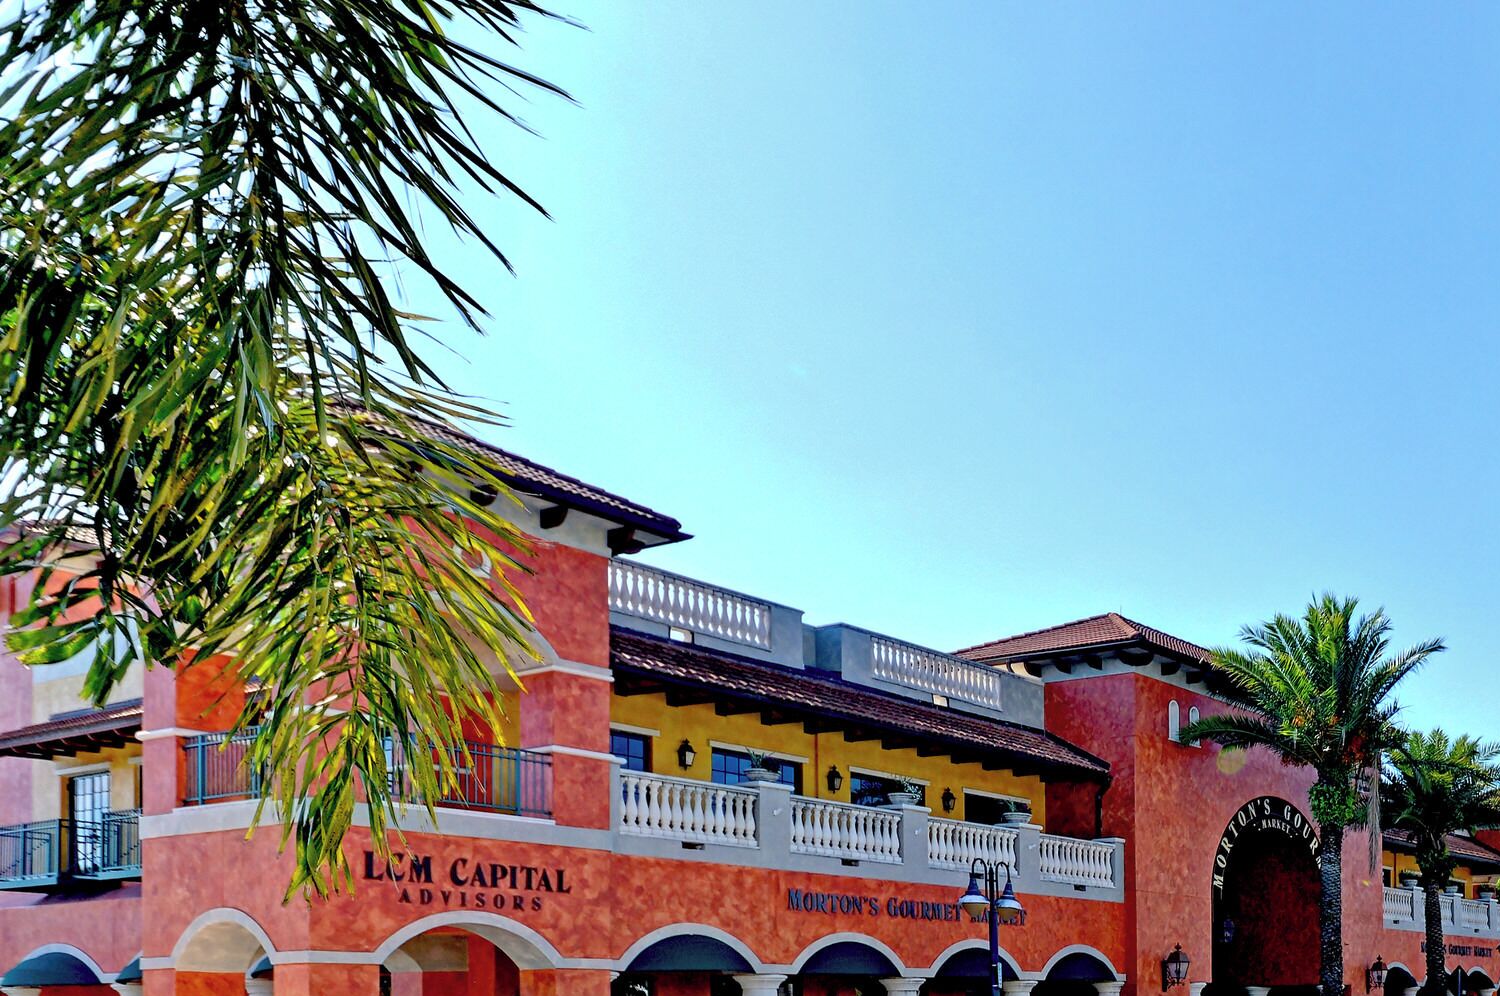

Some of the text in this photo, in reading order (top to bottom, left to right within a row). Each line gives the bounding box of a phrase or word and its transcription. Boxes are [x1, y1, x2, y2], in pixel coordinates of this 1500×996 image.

[1213, 798, 1271, 889] MORTON'S
[1262, 818, 1291, 834] MARKET
[363, 850, 572, 894] LCM CAPITAL
[398, 886, 542, 912] ADVISORS
[787, 887, 878, 917] MORTON'S
[886, 896, 962, 923] GOURMET
